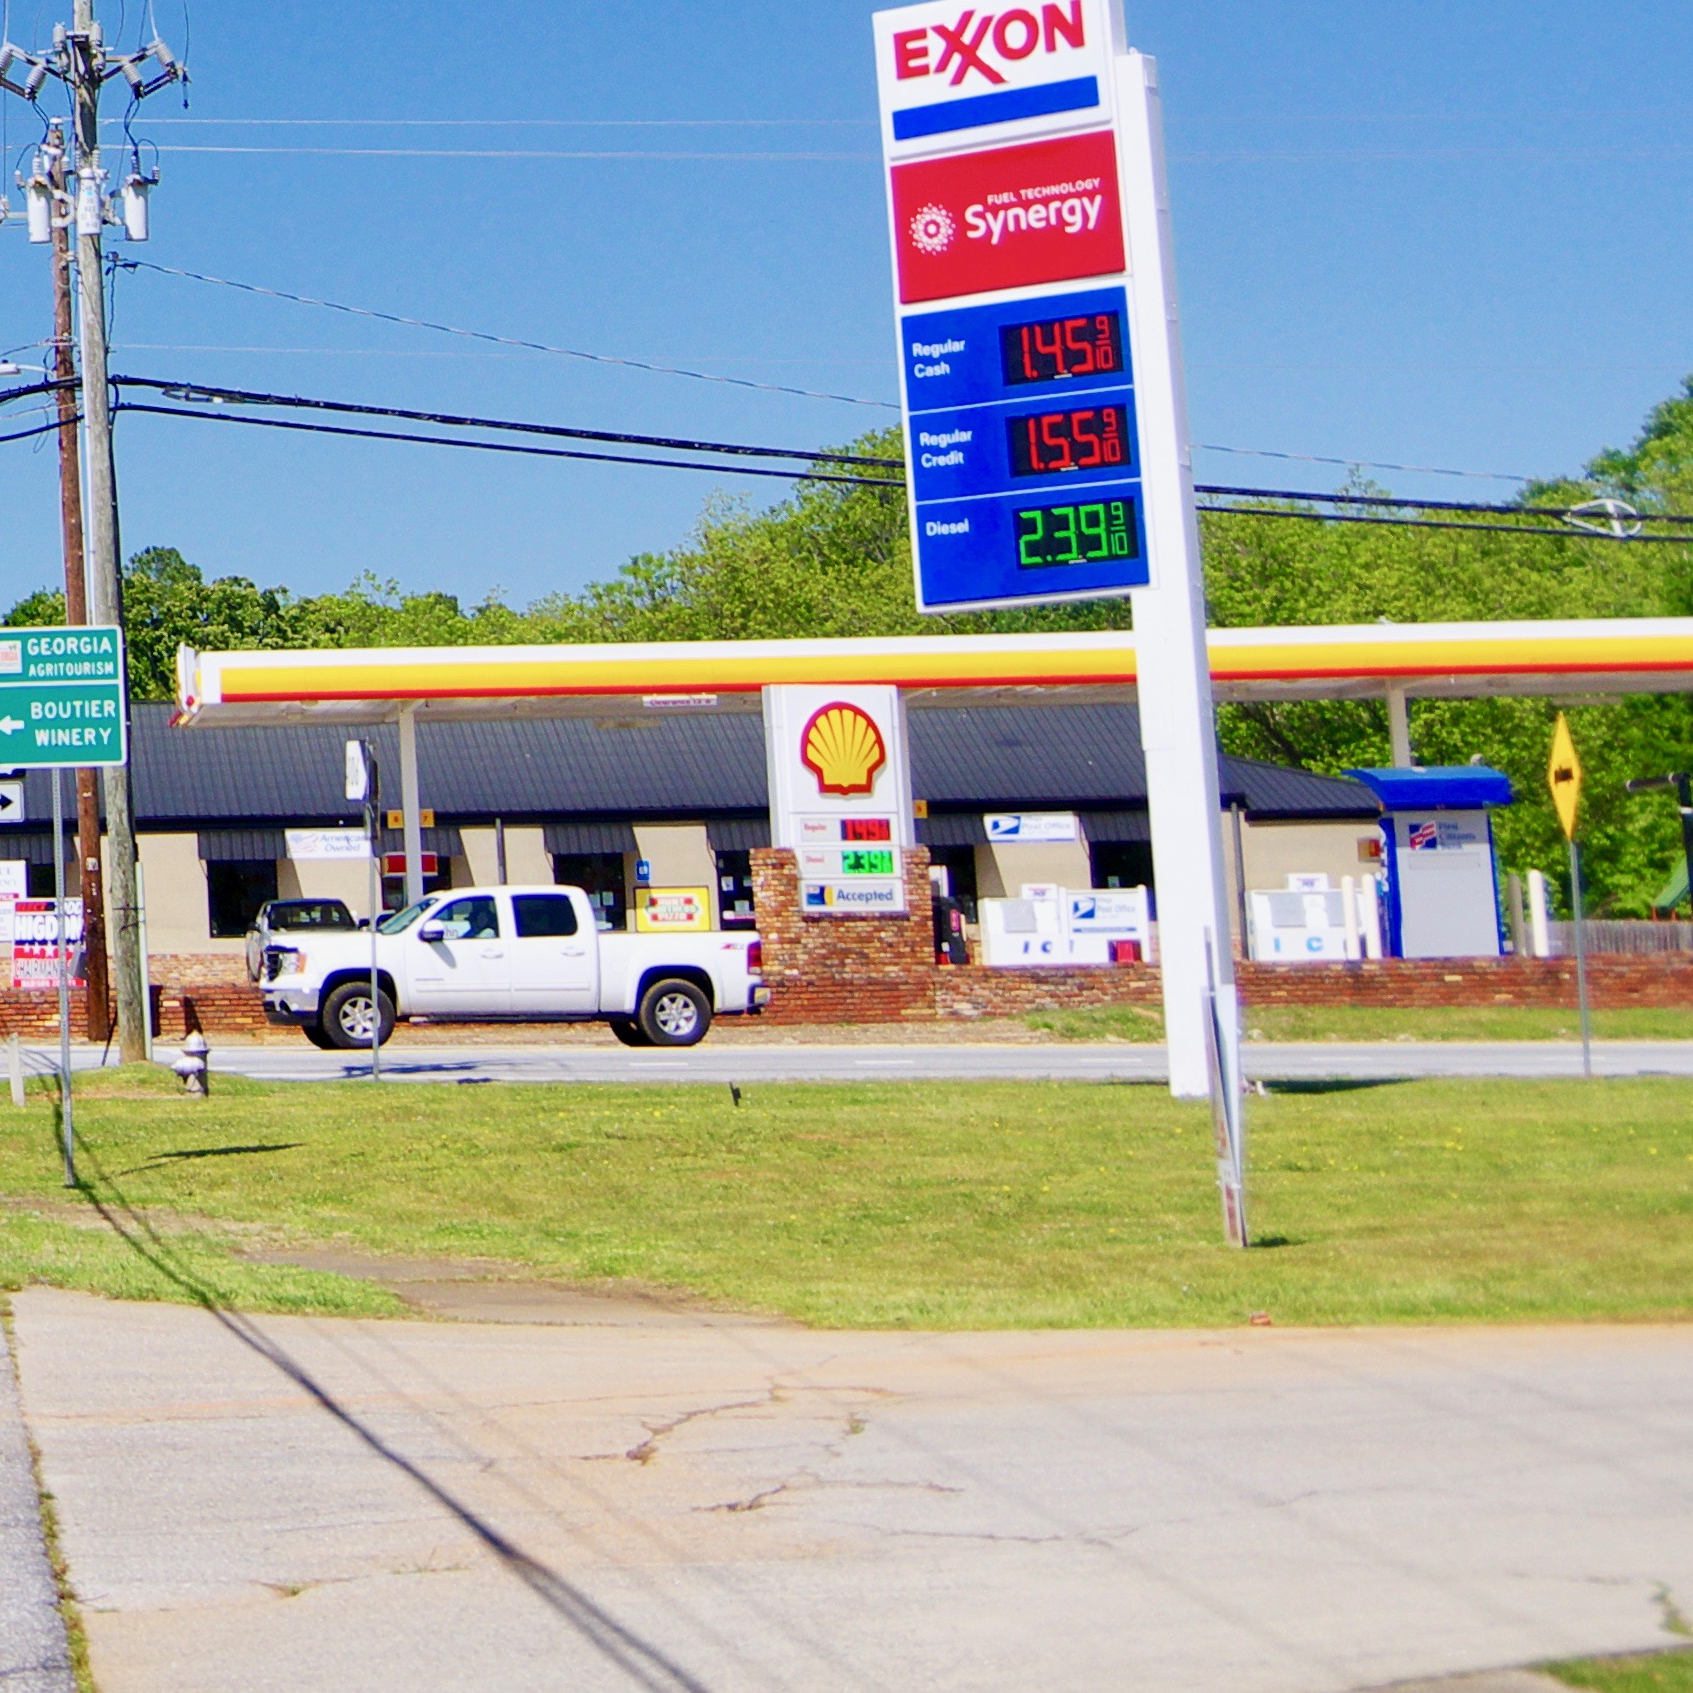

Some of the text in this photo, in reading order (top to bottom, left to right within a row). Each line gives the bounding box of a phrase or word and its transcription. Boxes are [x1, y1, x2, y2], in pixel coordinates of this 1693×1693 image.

[987, 177, 1101, 206] FUEL TECHNOLOGY
[965, 194, 1102, 245] Synergy
[912, 339, 965, 358] Regular
[914, 361, 950, 378] Cash
[919, 429, 973, 448] Regular
[921, 451, 964, 468] Credit
[926, 518, 970, 536] Diesel
[27, 636, 113, 656] GEORGIA
[28, 661, 114, 677] AGRITOURISM
[30, 700, 115, 719] BOUTIER
[35, 727, 112, 746] WINERY
[324, 843, 360, 852] Owned
[837, 888, 893, 903] Accepted
